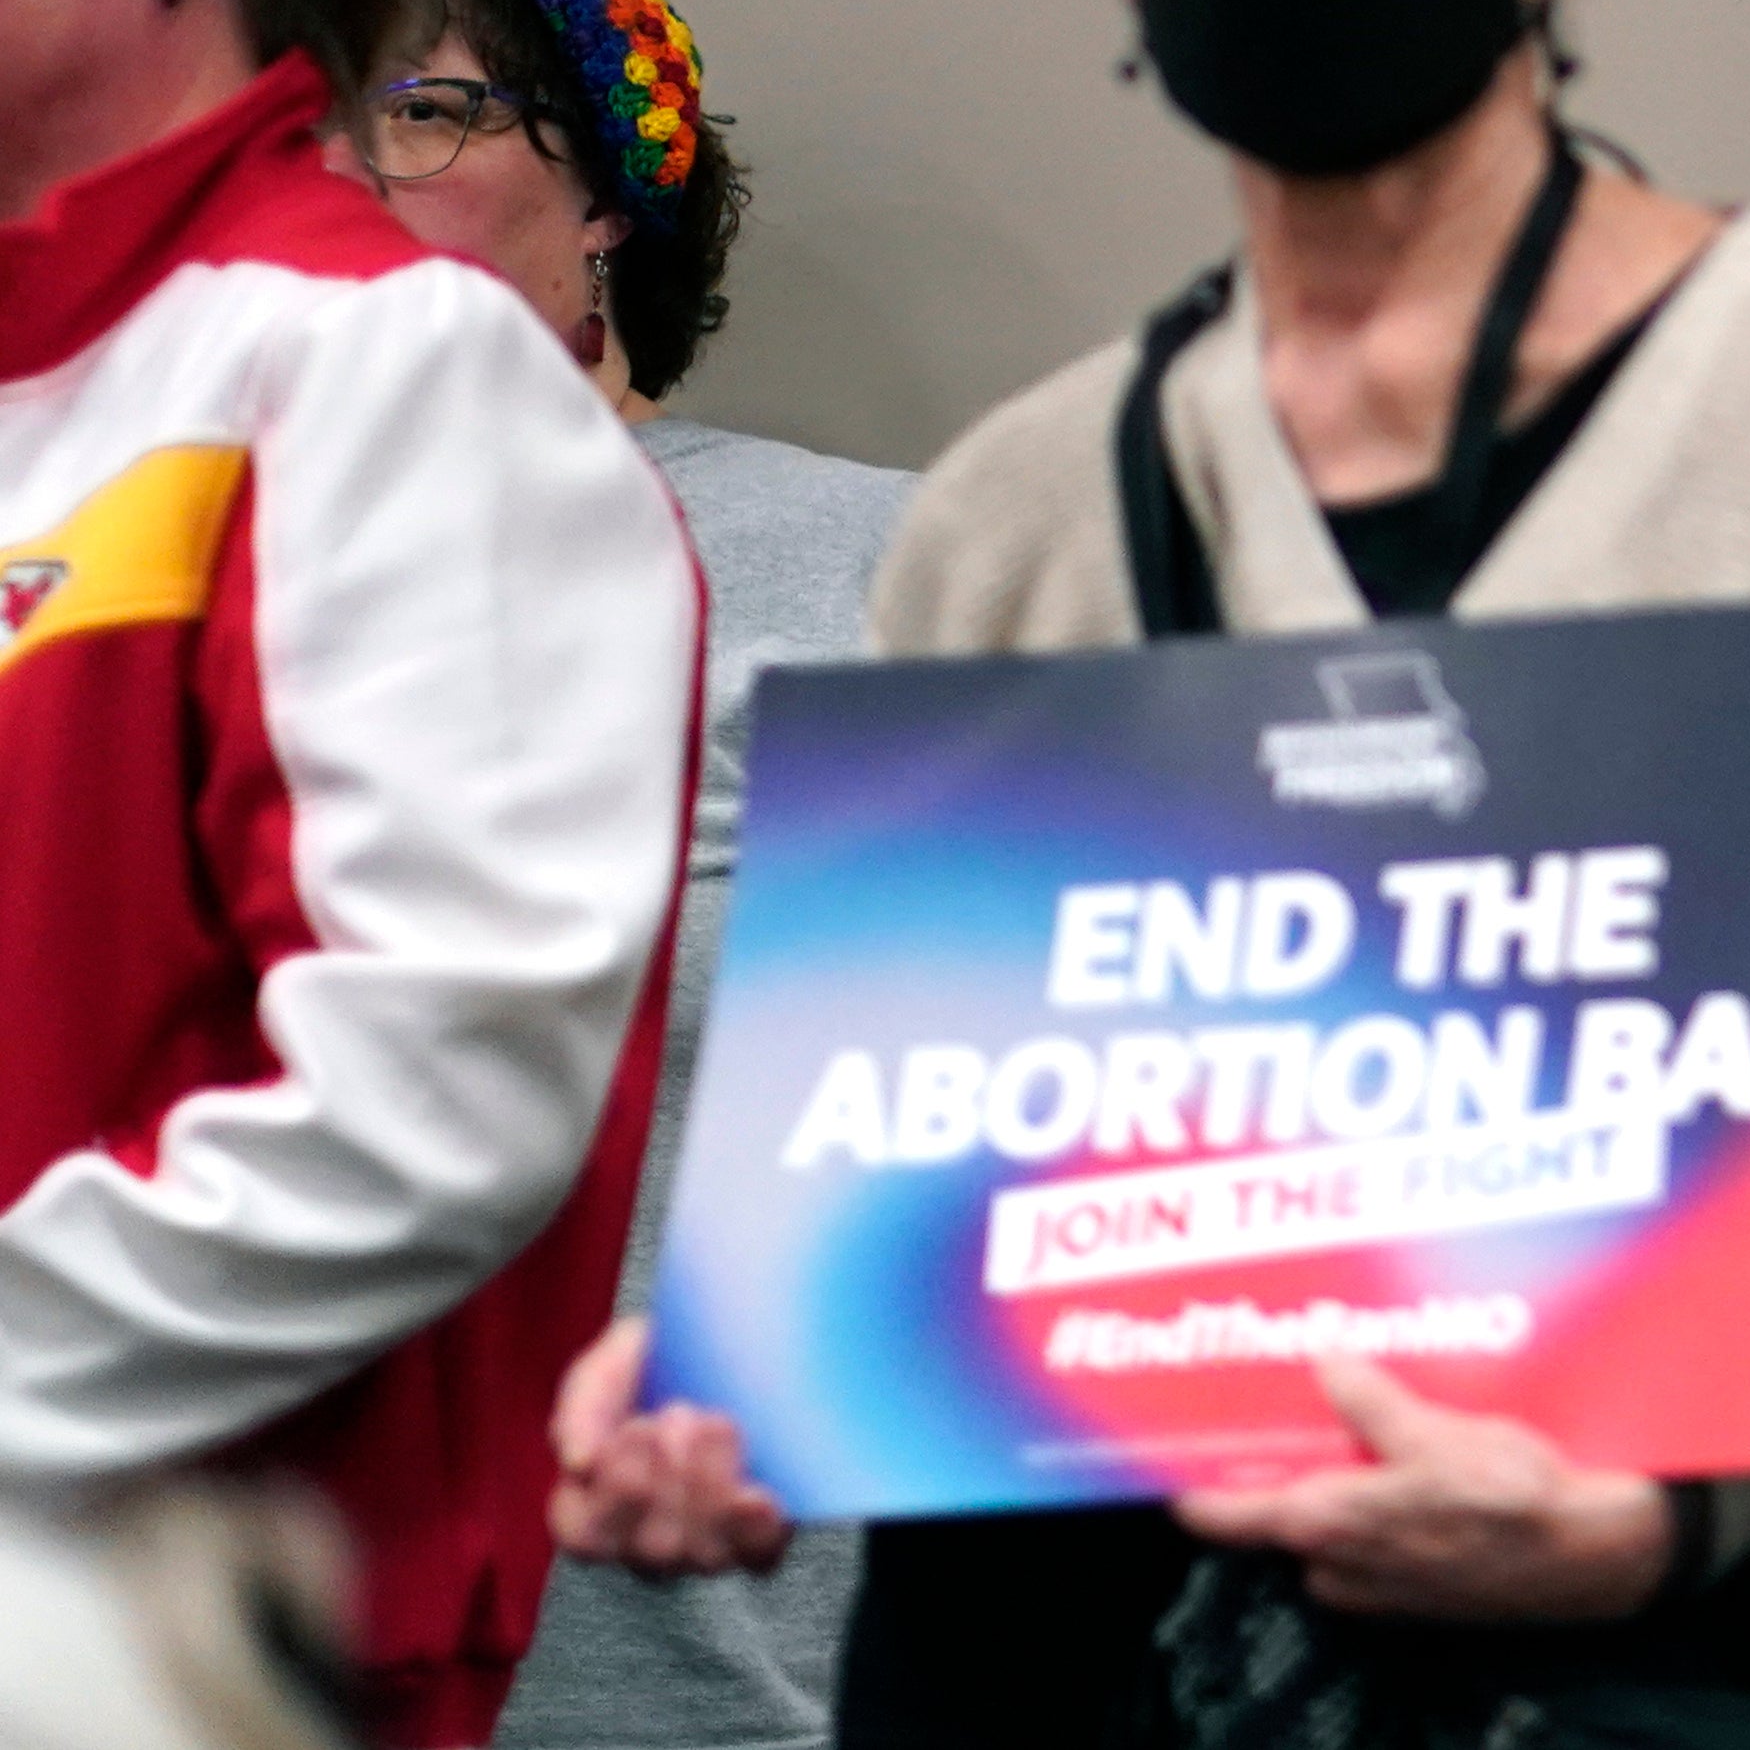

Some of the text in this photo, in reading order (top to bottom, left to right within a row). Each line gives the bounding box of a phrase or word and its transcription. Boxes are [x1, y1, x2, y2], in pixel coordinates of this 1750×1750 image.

[1046, 846, 1667, 1010] END THE
[782, 1005, 1540, 1172] ABORTION
[1024, 1190, 1193, 1280] JOIN
[1230, 1165, 1361, 1229] THE
